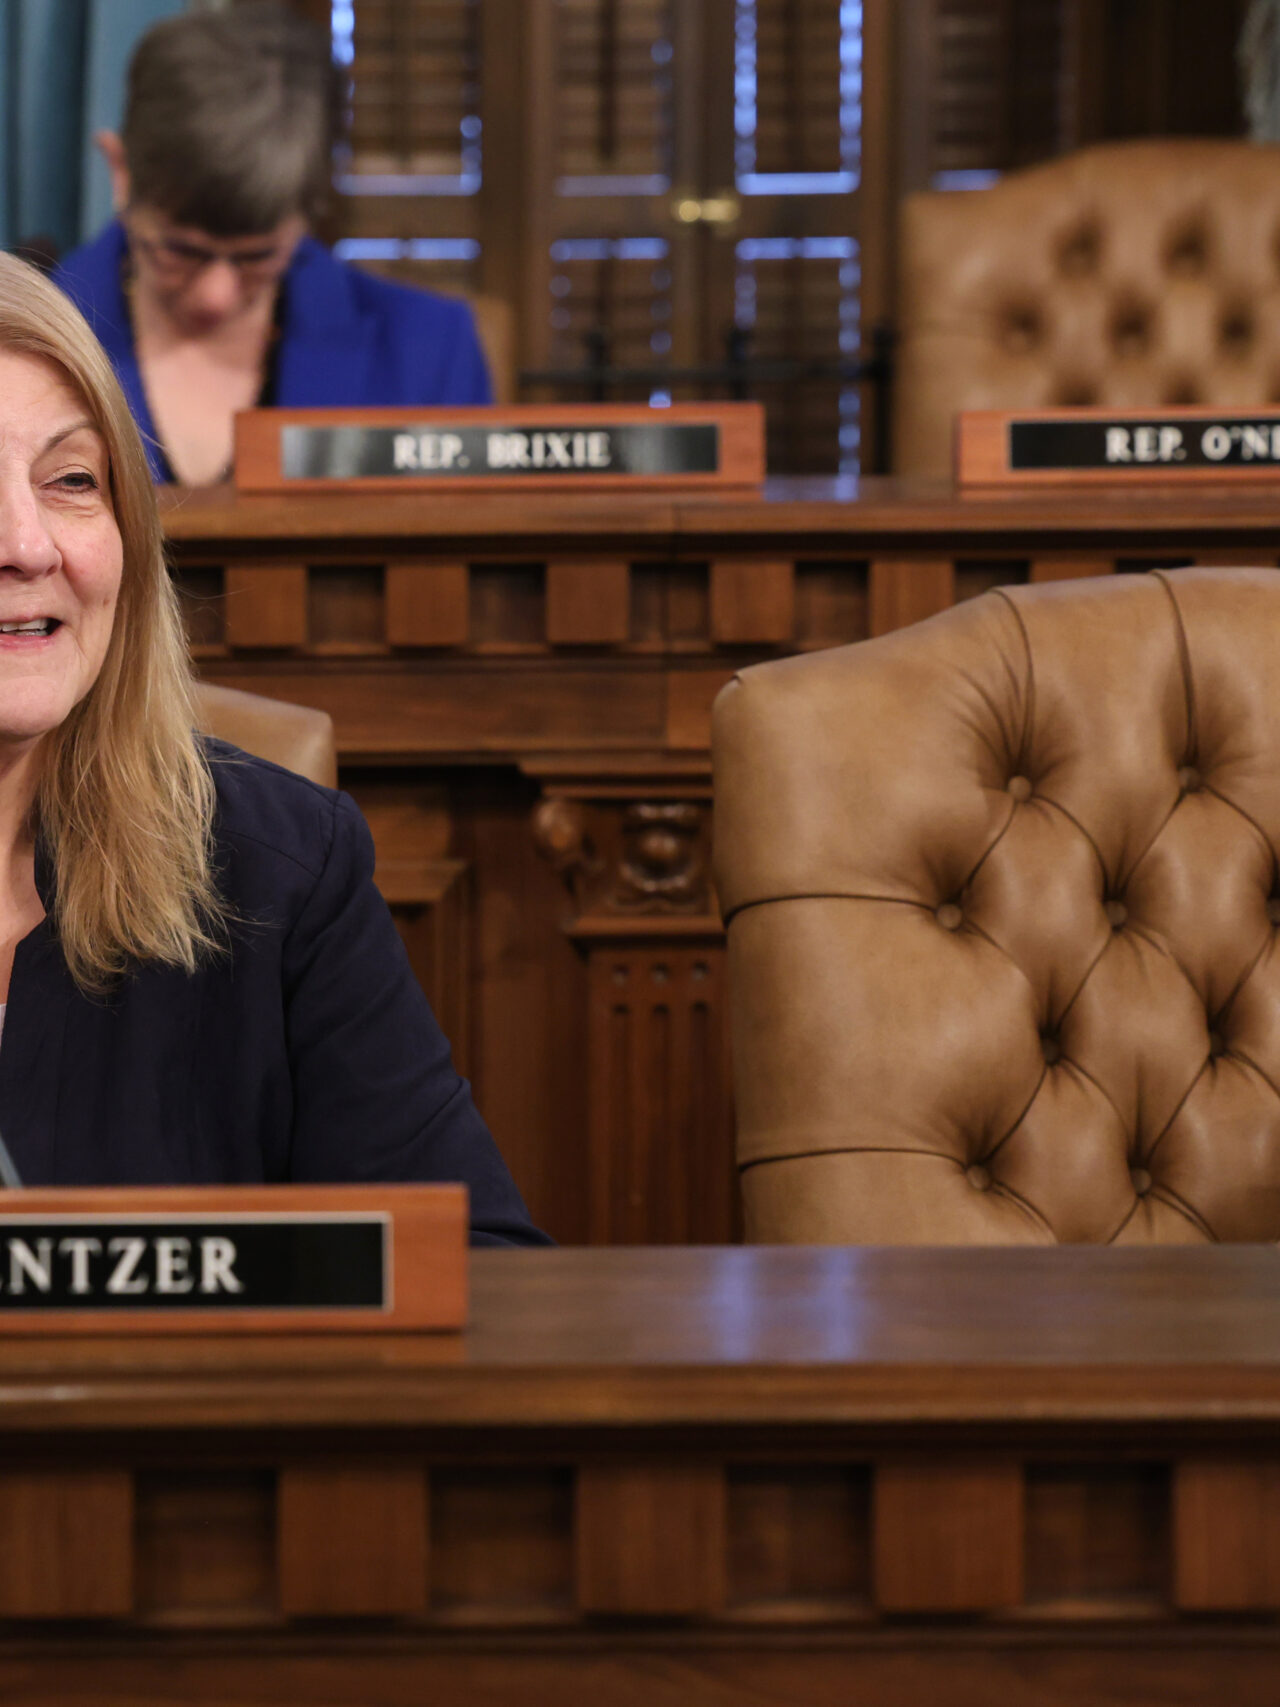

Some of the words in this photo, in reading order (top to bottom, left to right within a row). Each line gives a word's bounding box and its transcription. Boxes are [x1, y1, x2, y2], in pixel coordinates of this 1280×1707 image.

[393, 432, 471, 468] REP.
[487, 433, 611, 467] BRIXIE
[1105, 426, 1187, 461] REP.
